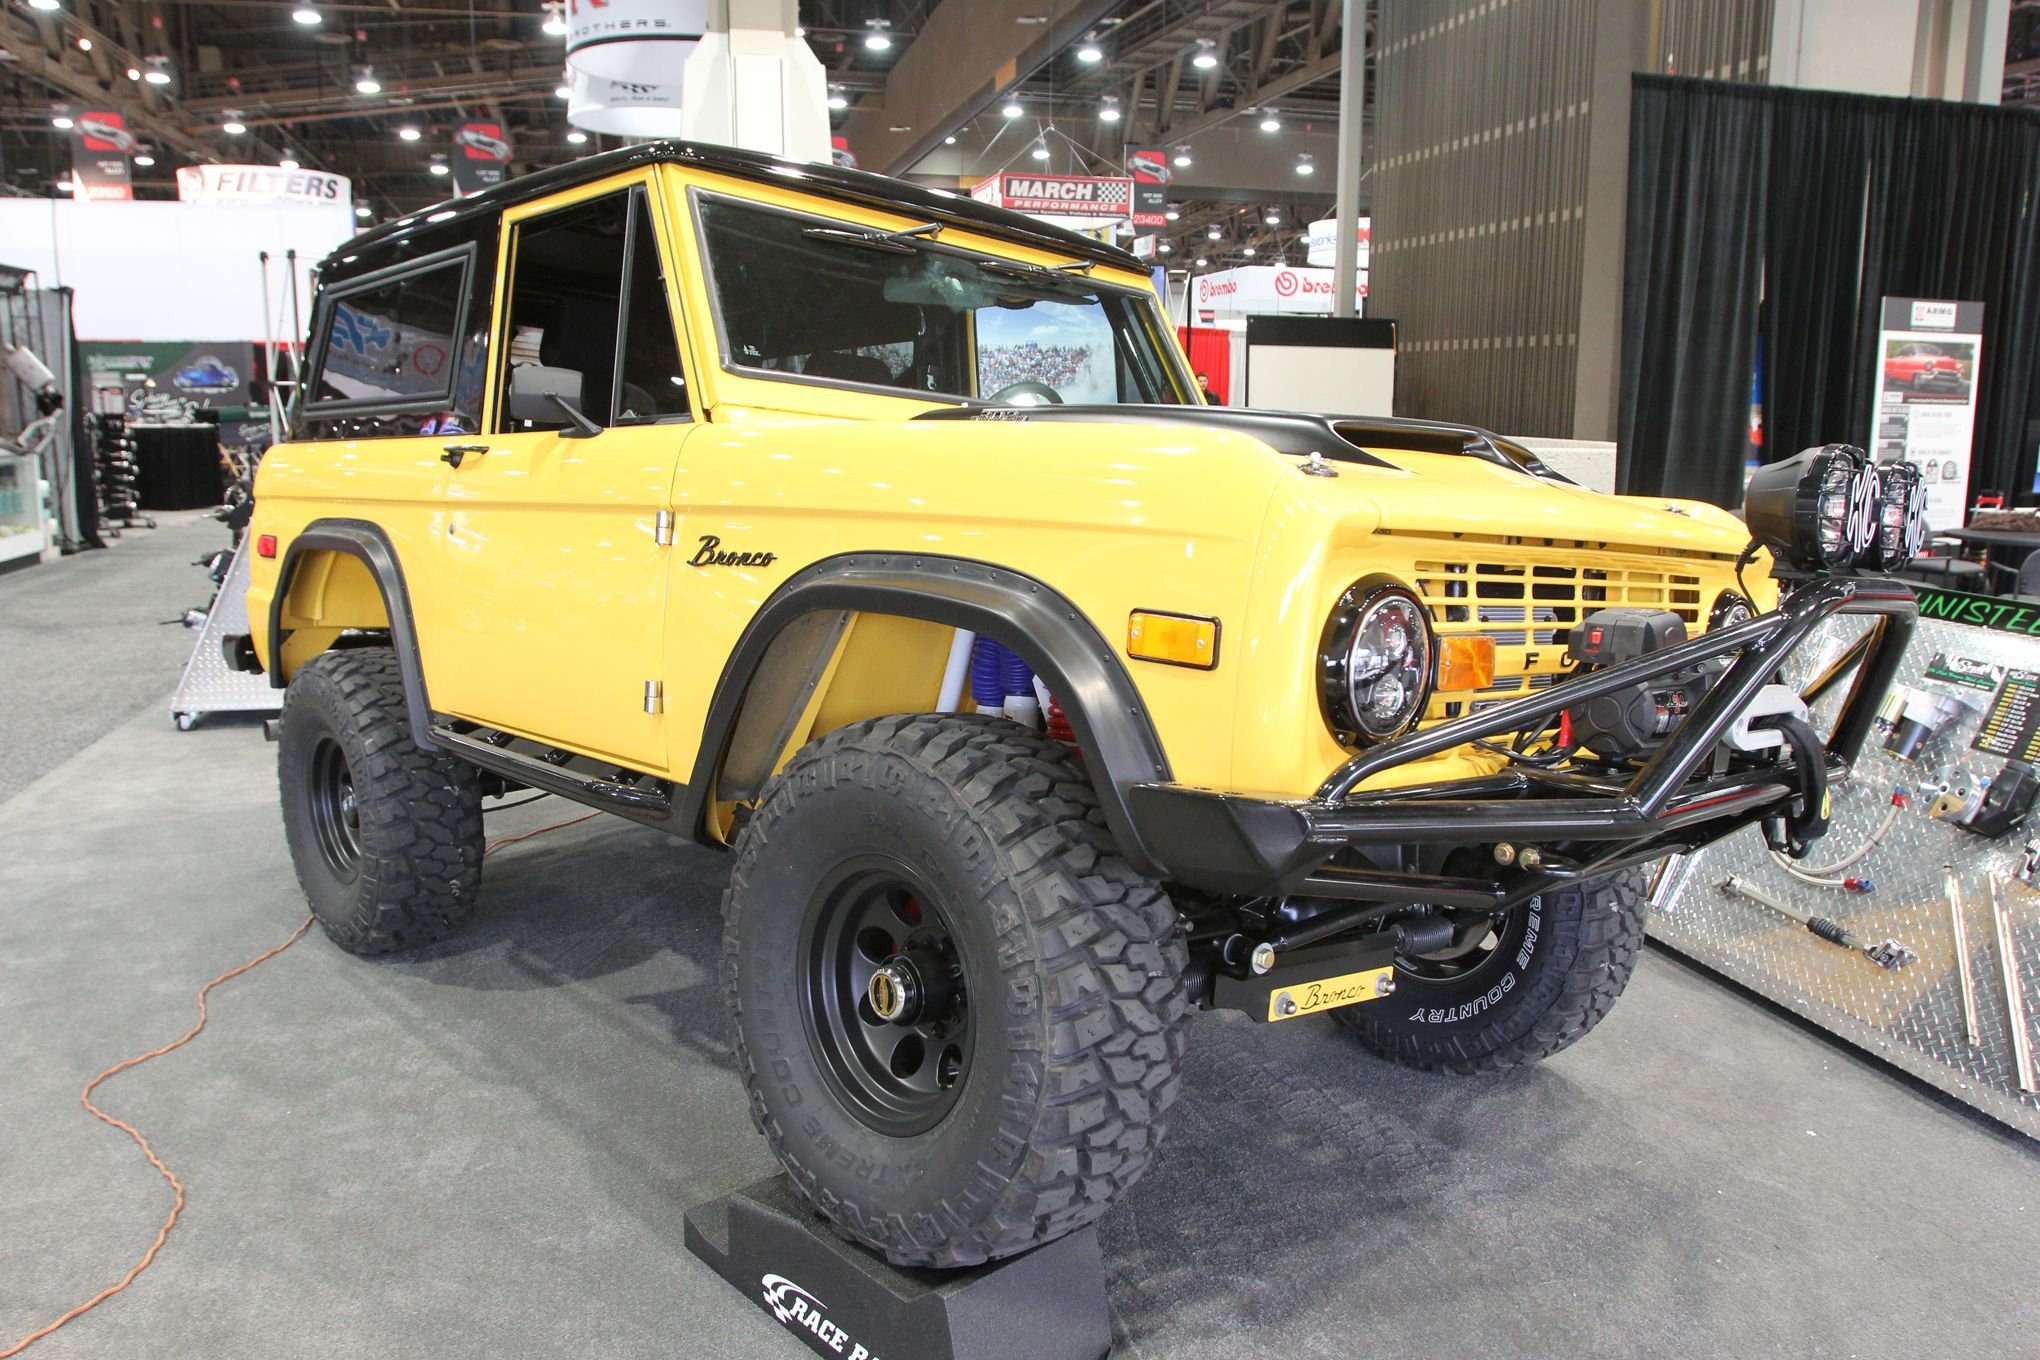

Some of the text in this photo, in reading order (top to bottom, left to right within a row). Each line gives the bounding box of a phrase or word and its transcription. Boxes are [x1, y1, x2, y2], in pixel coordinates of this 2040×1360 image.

[217, 171, 339, 200] FILTERS
[1009, 180, 1093, 200] MARCH
[1014, 199, 1118, 212] PERFORMANCE
[1133, 213, 1164, 225] 23400
[1209, 276, 1369, 297] brembo breo
[1847, 464, 1881, 553] KC
[686, 534, 778, 568] Bronco
[1300, 983, 1366, 1010] Bronco
[1408, 971, 1516, 1024] COUNTRY
[789, 1296, 850, 1354] RACE
